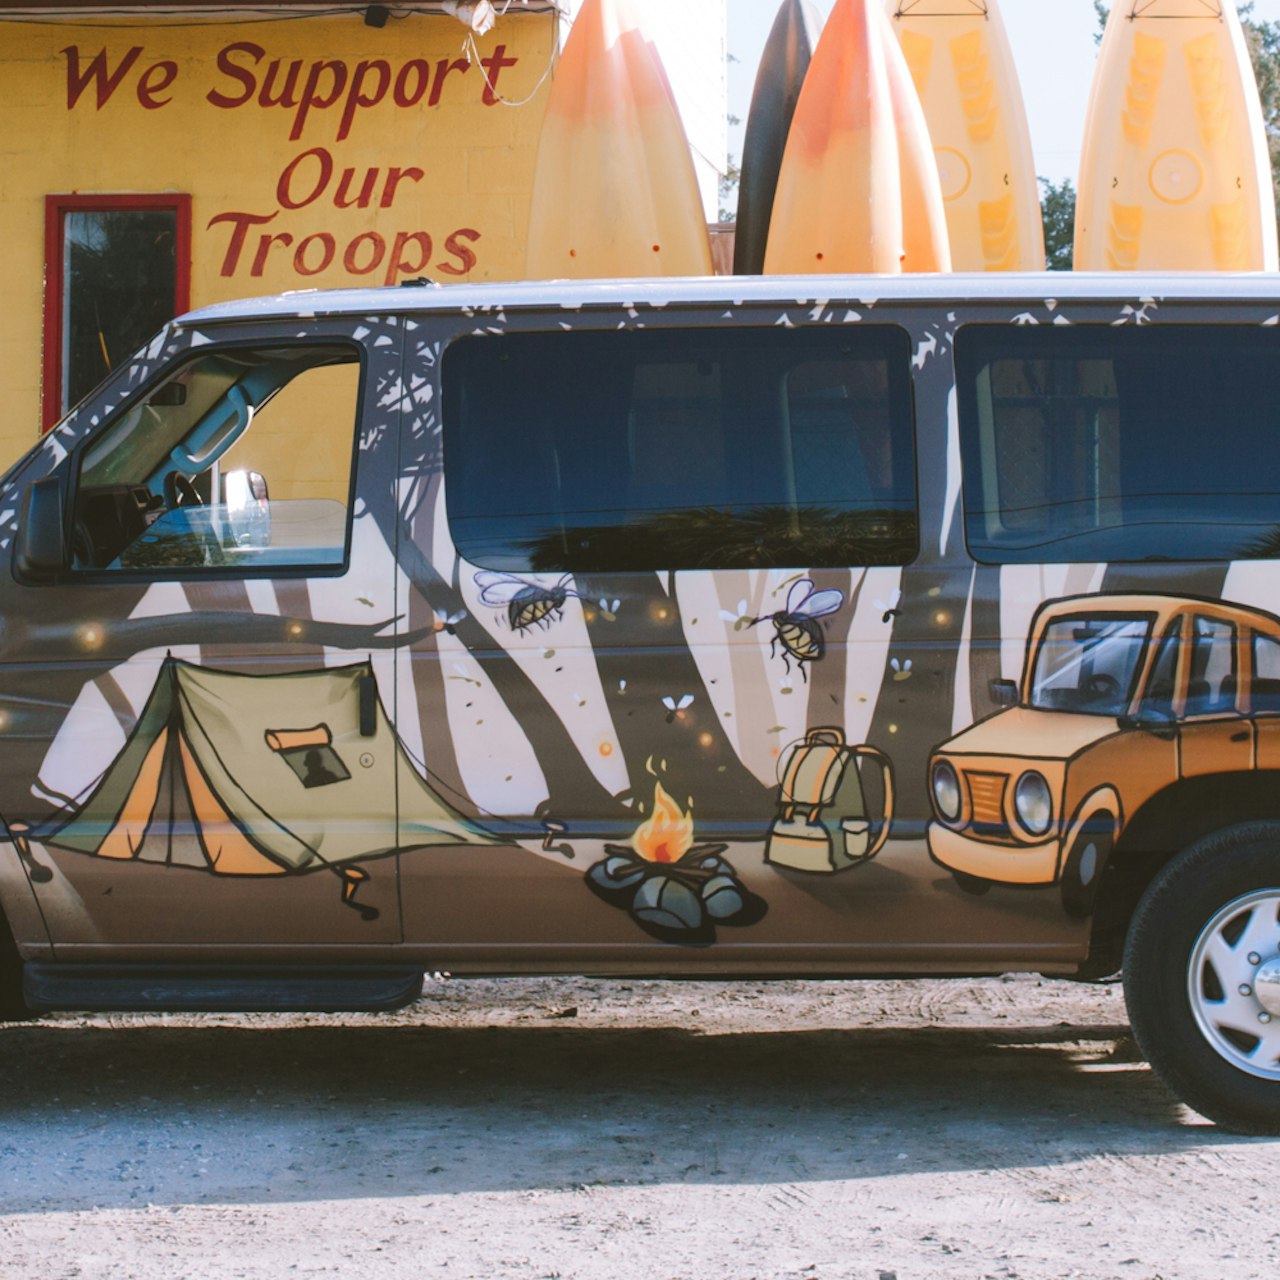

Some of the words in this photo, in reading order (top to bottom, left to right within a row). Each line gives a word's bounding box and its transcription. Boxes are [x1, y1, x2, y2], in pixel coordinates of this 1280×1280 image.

[59, 44, 179, 111] We
[206, 41, 519, 142] Support
[276, 147, 425, 211] Our
[206, 210, 482, 287] Troops
